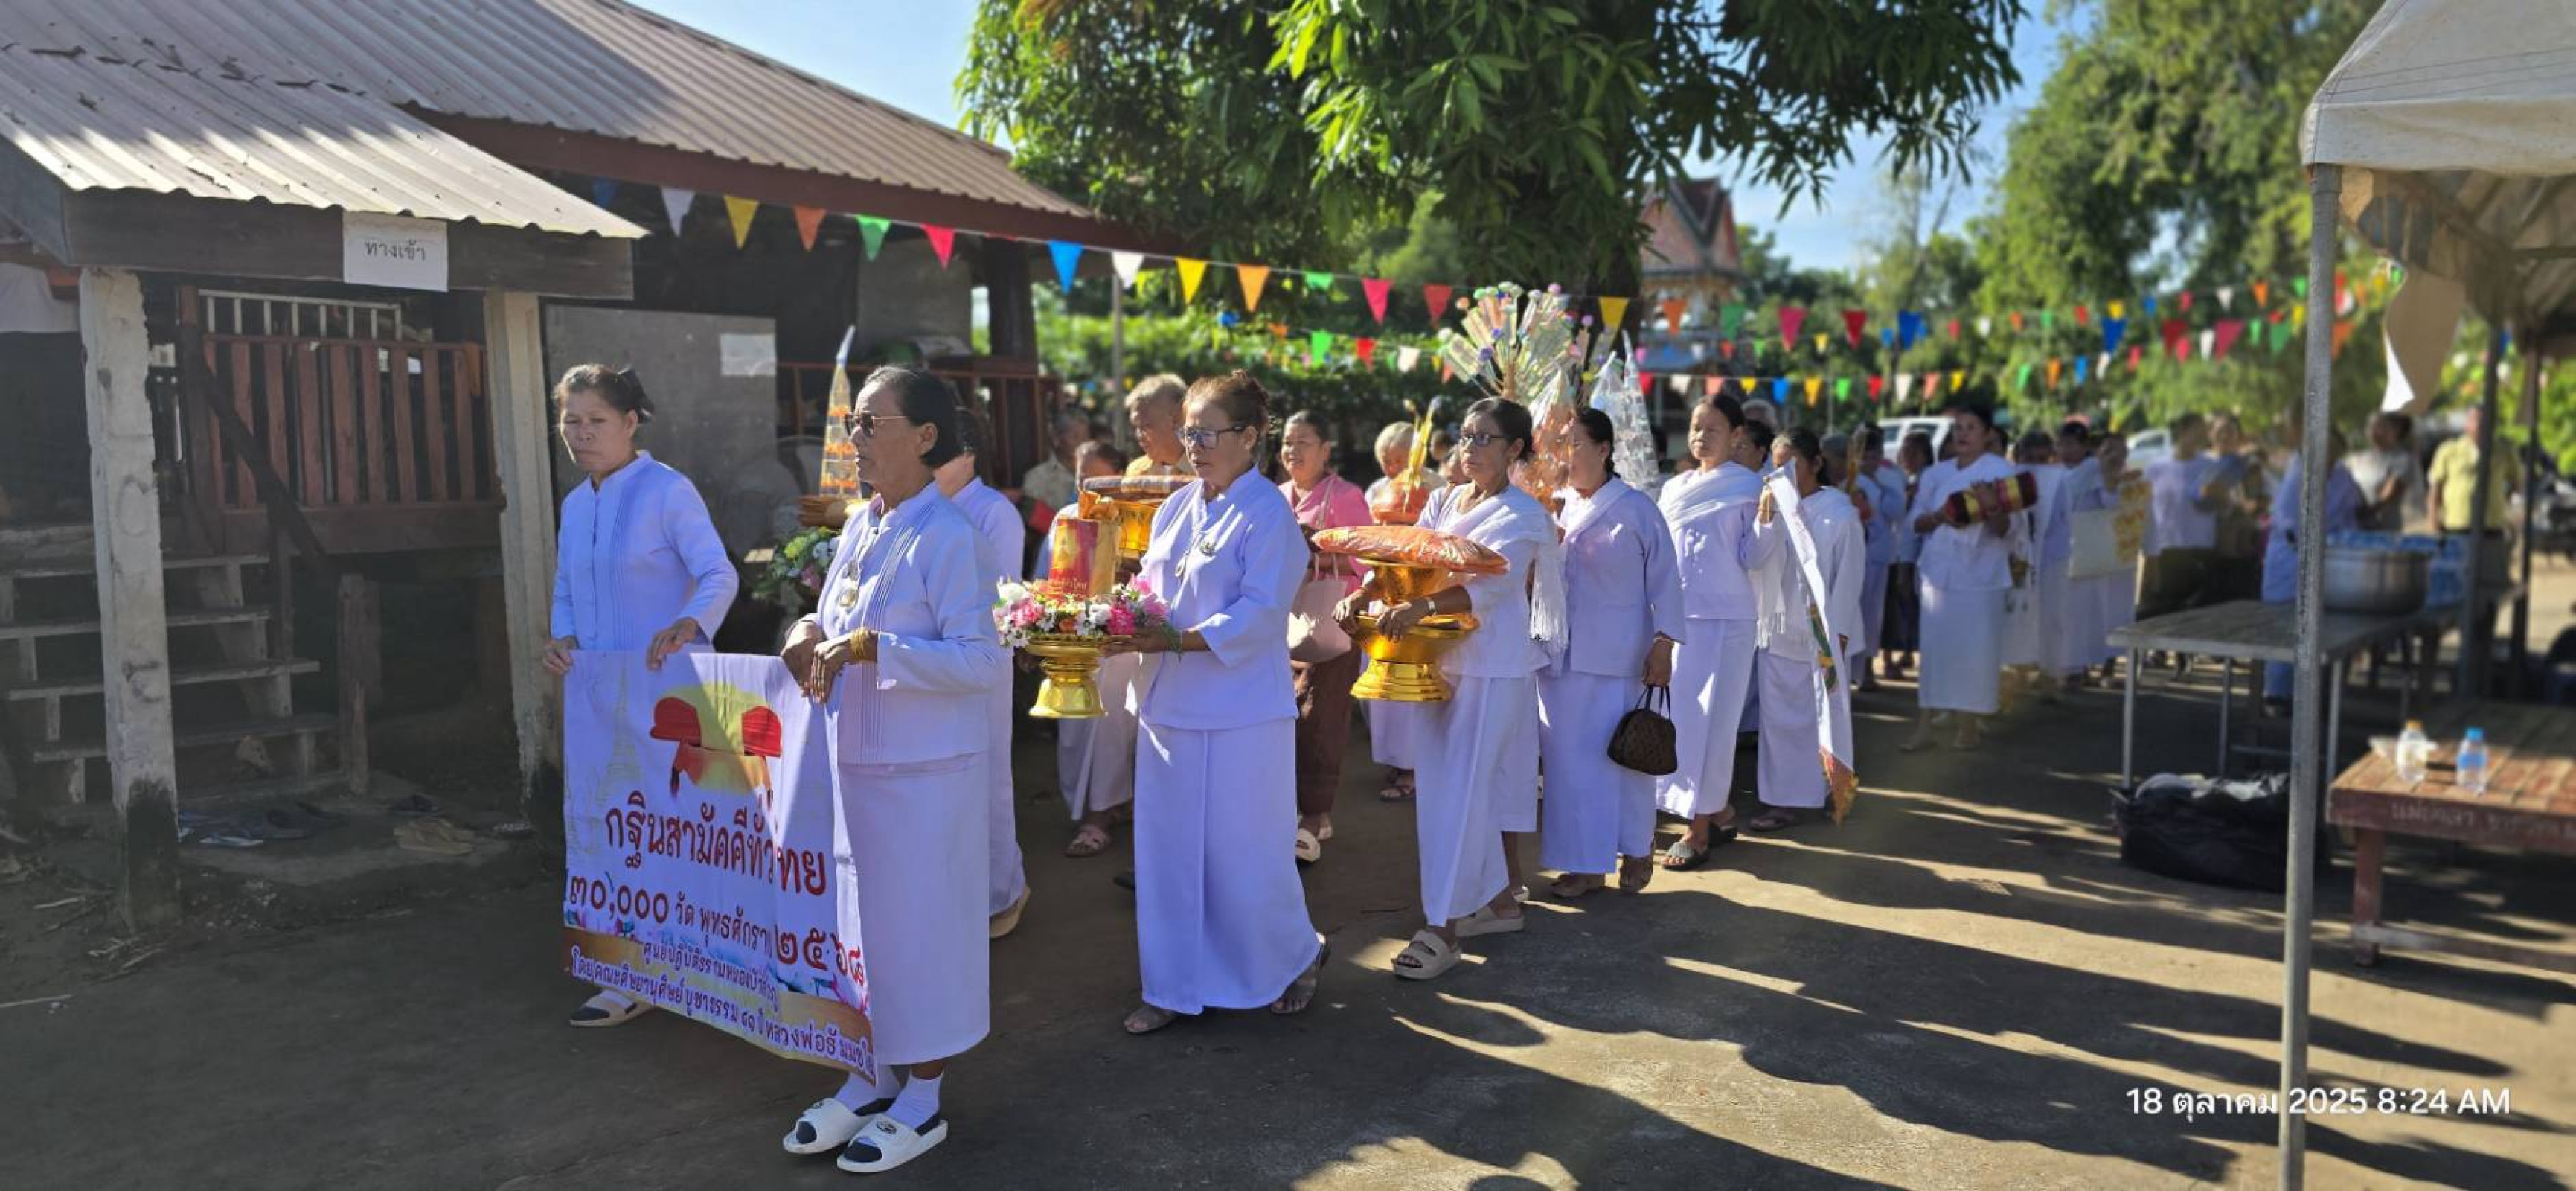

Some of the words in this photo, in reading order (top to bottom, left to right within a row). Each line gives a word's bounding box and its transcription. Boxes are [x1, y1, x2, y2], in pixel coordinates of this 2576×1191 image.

[365, 239, 426, 261] ทางเข้า
[605, 788, 827, 896] กฐินสามัคคีทั่วทย
[675, 891, 695, 927] วัด
[699, 905, 773, 959] พุทธศักรา
[775, 924, 865, 986] ๒๕๖๘
